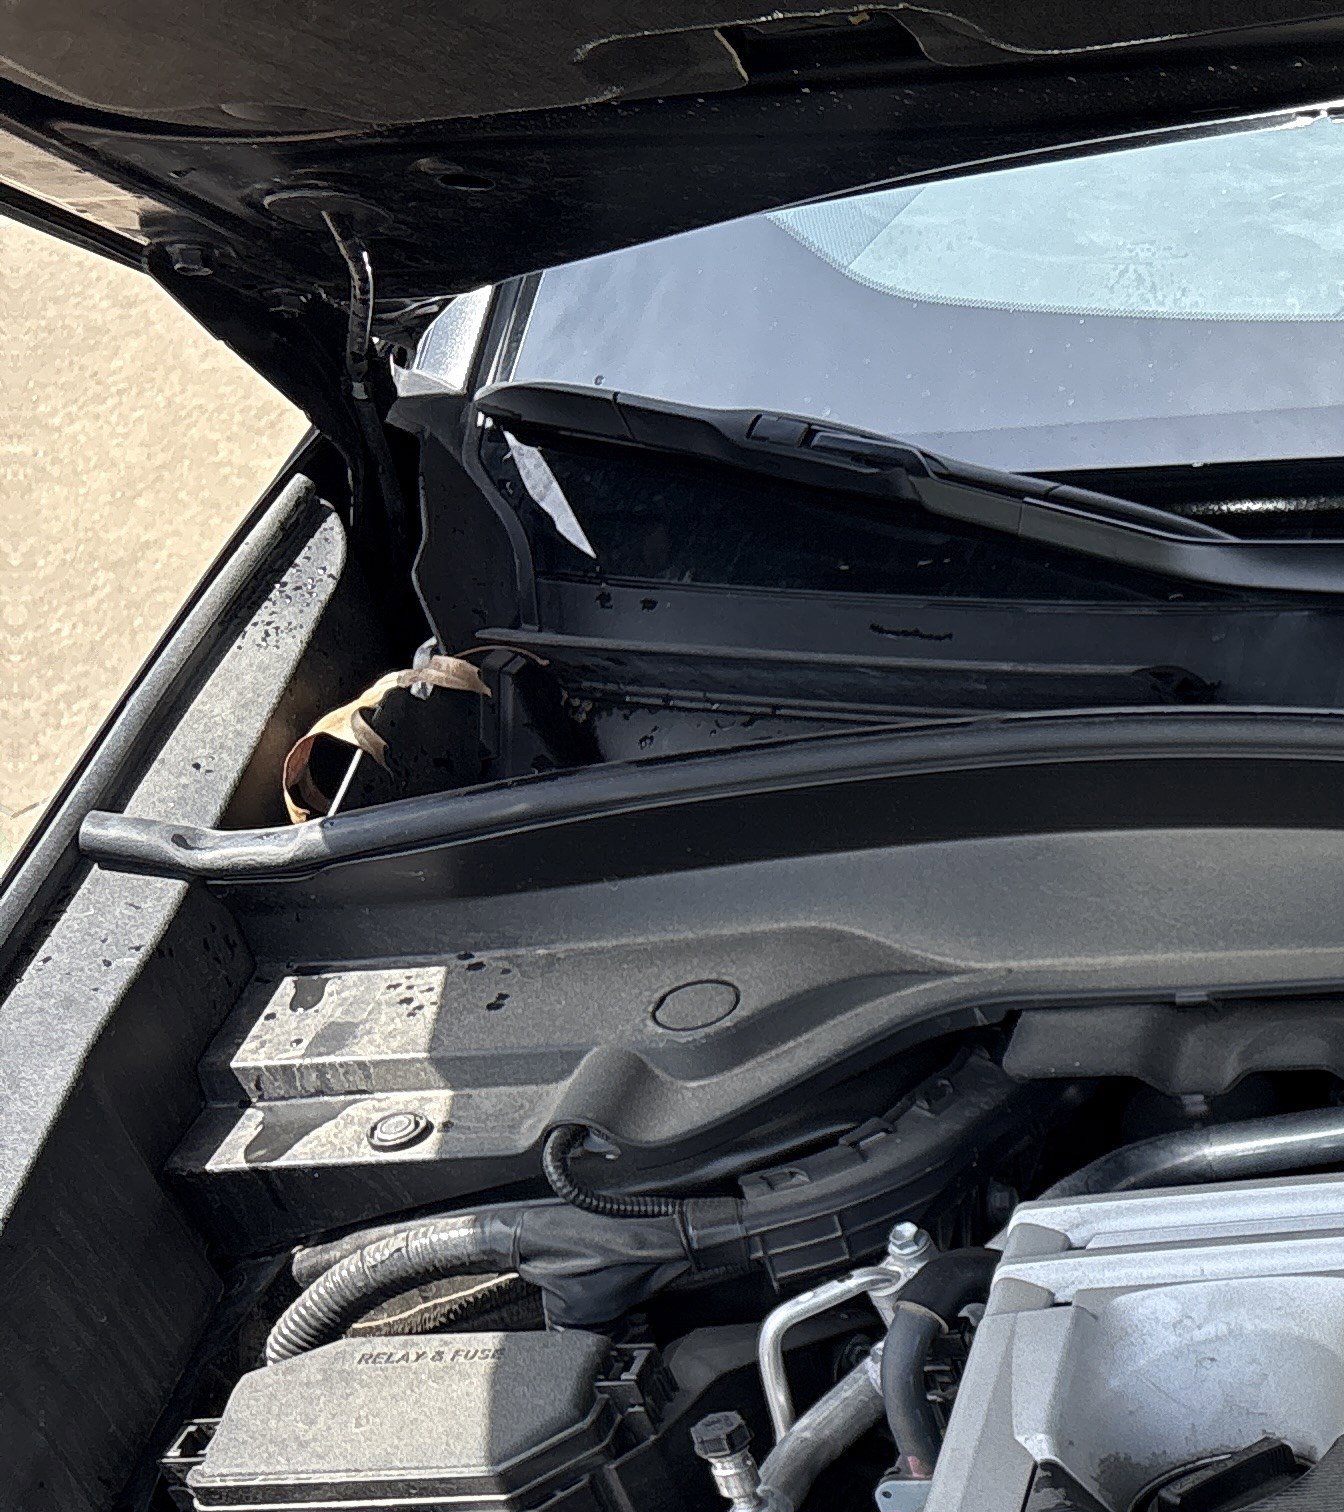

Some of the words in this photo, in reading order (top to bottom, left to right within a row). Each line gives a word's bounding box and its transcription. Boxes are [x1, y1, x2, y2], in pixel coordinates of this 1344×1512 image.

[357, 1350, 428, 1365] RELAY
[429, 1351, 444, 1363] &
[450, 1347, 506, 1362] FUSE
